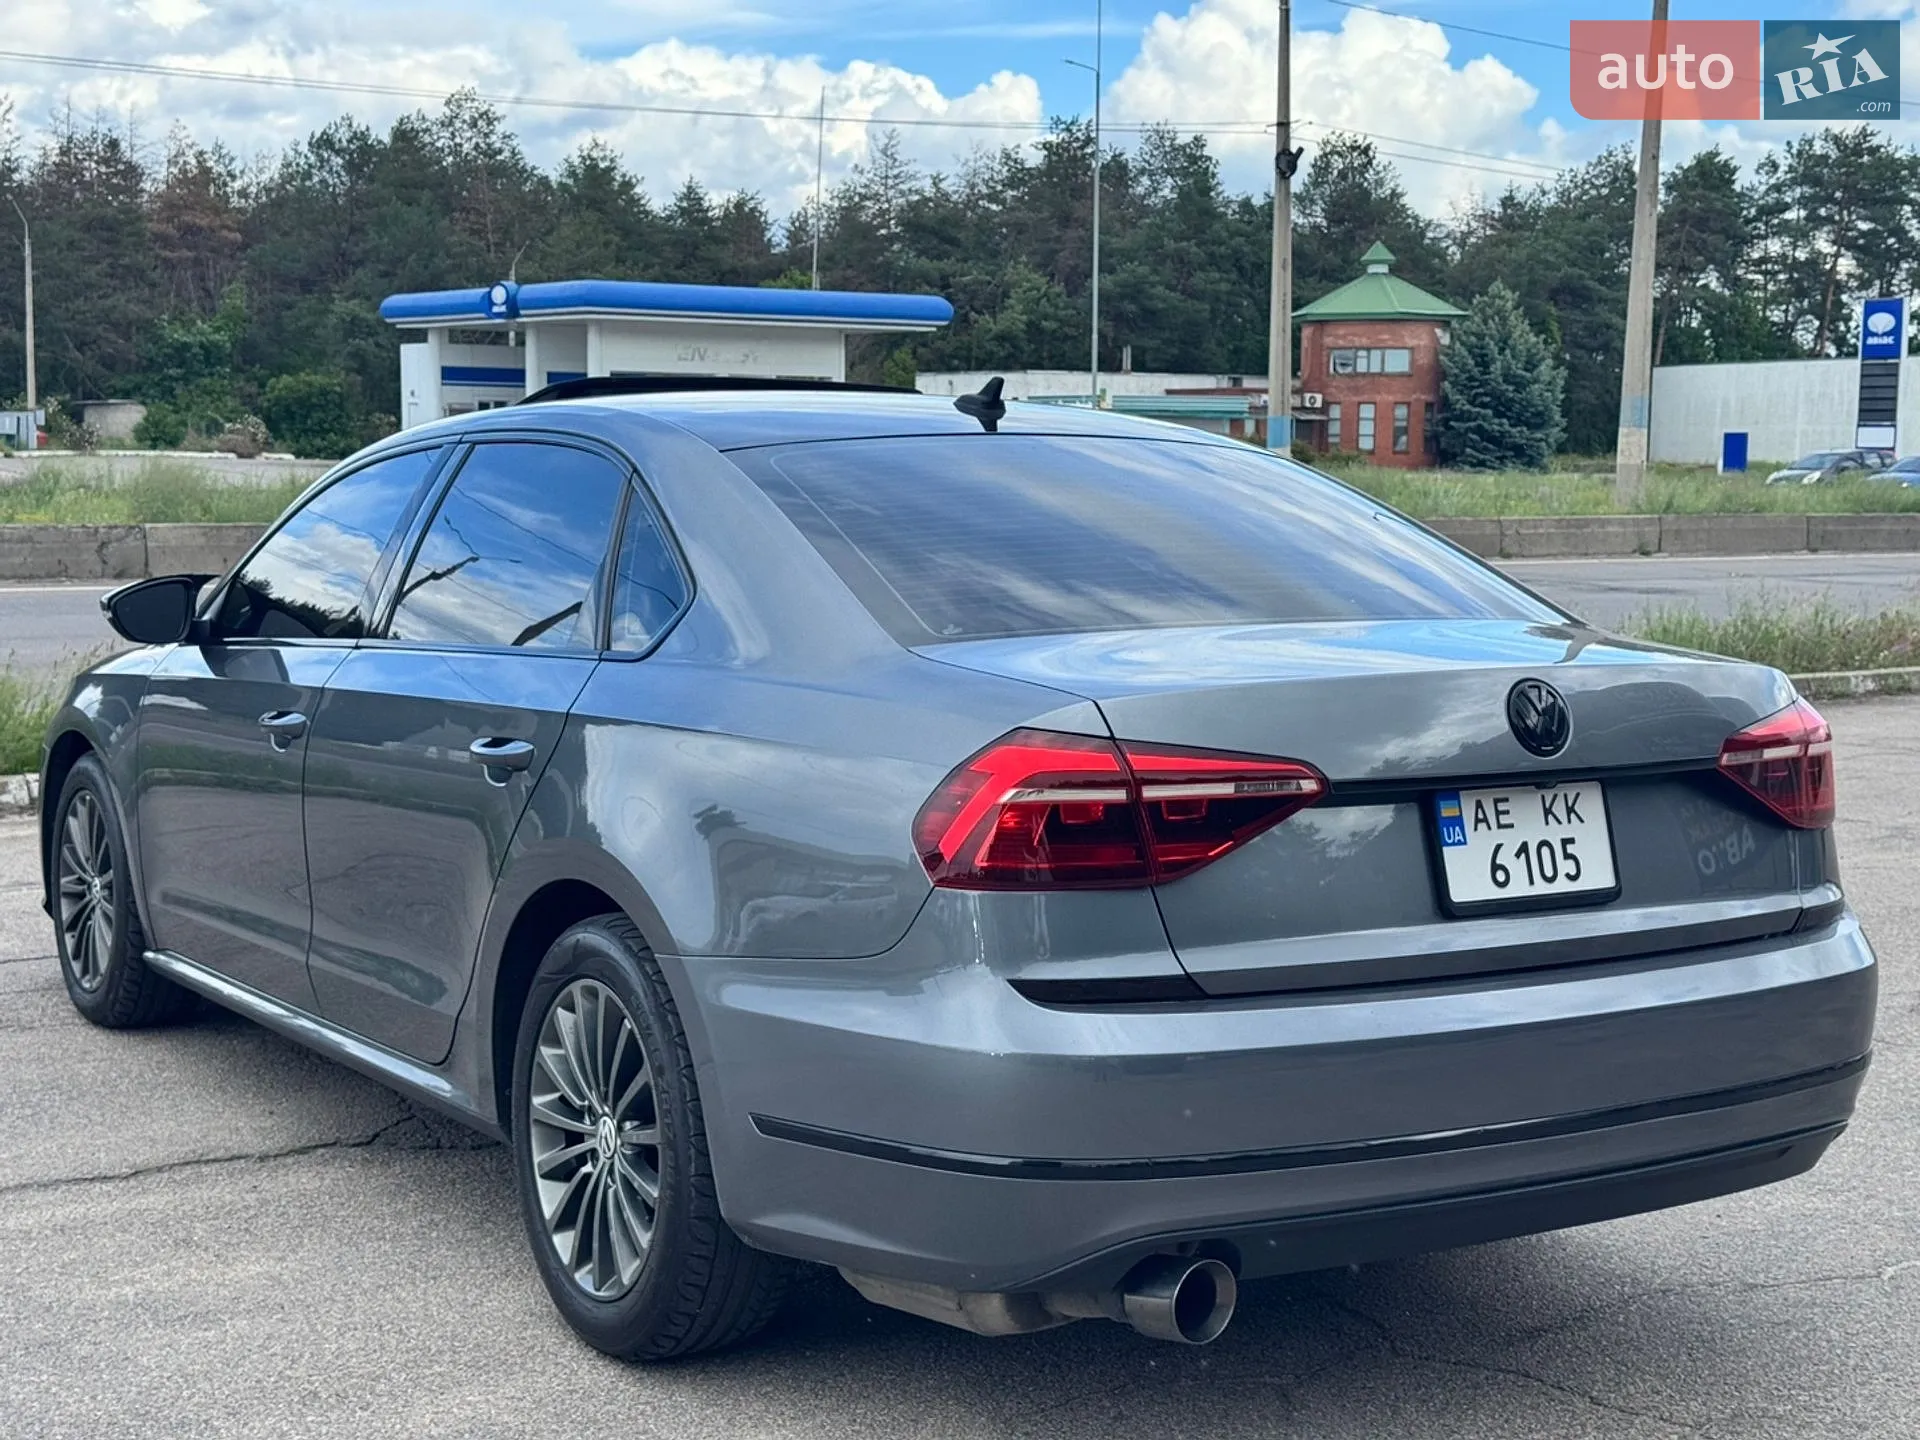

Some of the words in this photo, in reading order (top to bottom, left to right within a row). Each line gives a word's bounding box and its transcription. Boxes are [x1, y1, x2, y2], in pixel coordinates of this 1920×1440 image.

[1473, 797, 1515, 832] AE
[1540, 792, 1585, 826] KK
[1443, 826, 1465, 844] UA
[1490, 837, 1582, 888] 6105
